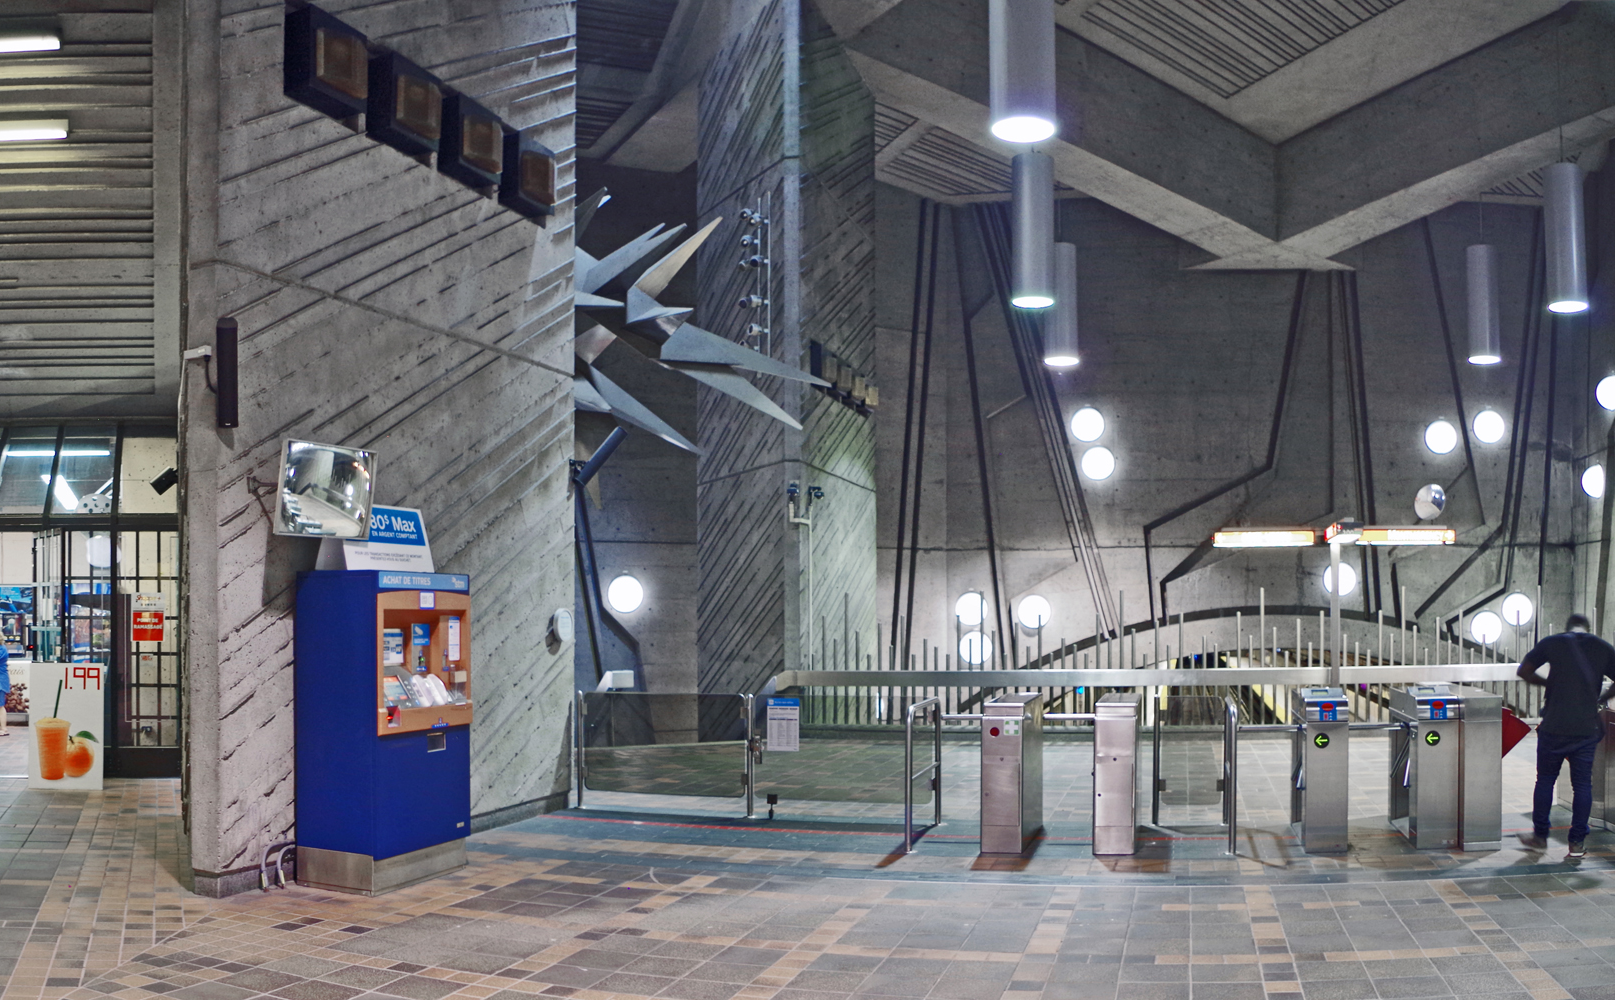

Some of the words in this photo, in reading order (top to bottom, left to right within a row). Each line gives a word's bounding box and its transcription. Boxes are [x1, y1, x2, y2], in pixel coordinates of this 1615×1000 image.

[391, 516, 417, 533] Max
[382, 575, 402, 584] ACHAT
[403, 576, 411, 585] DE
[411, 577, 431, 586] TITRES
[64, 667, 100, 690] 1.99
